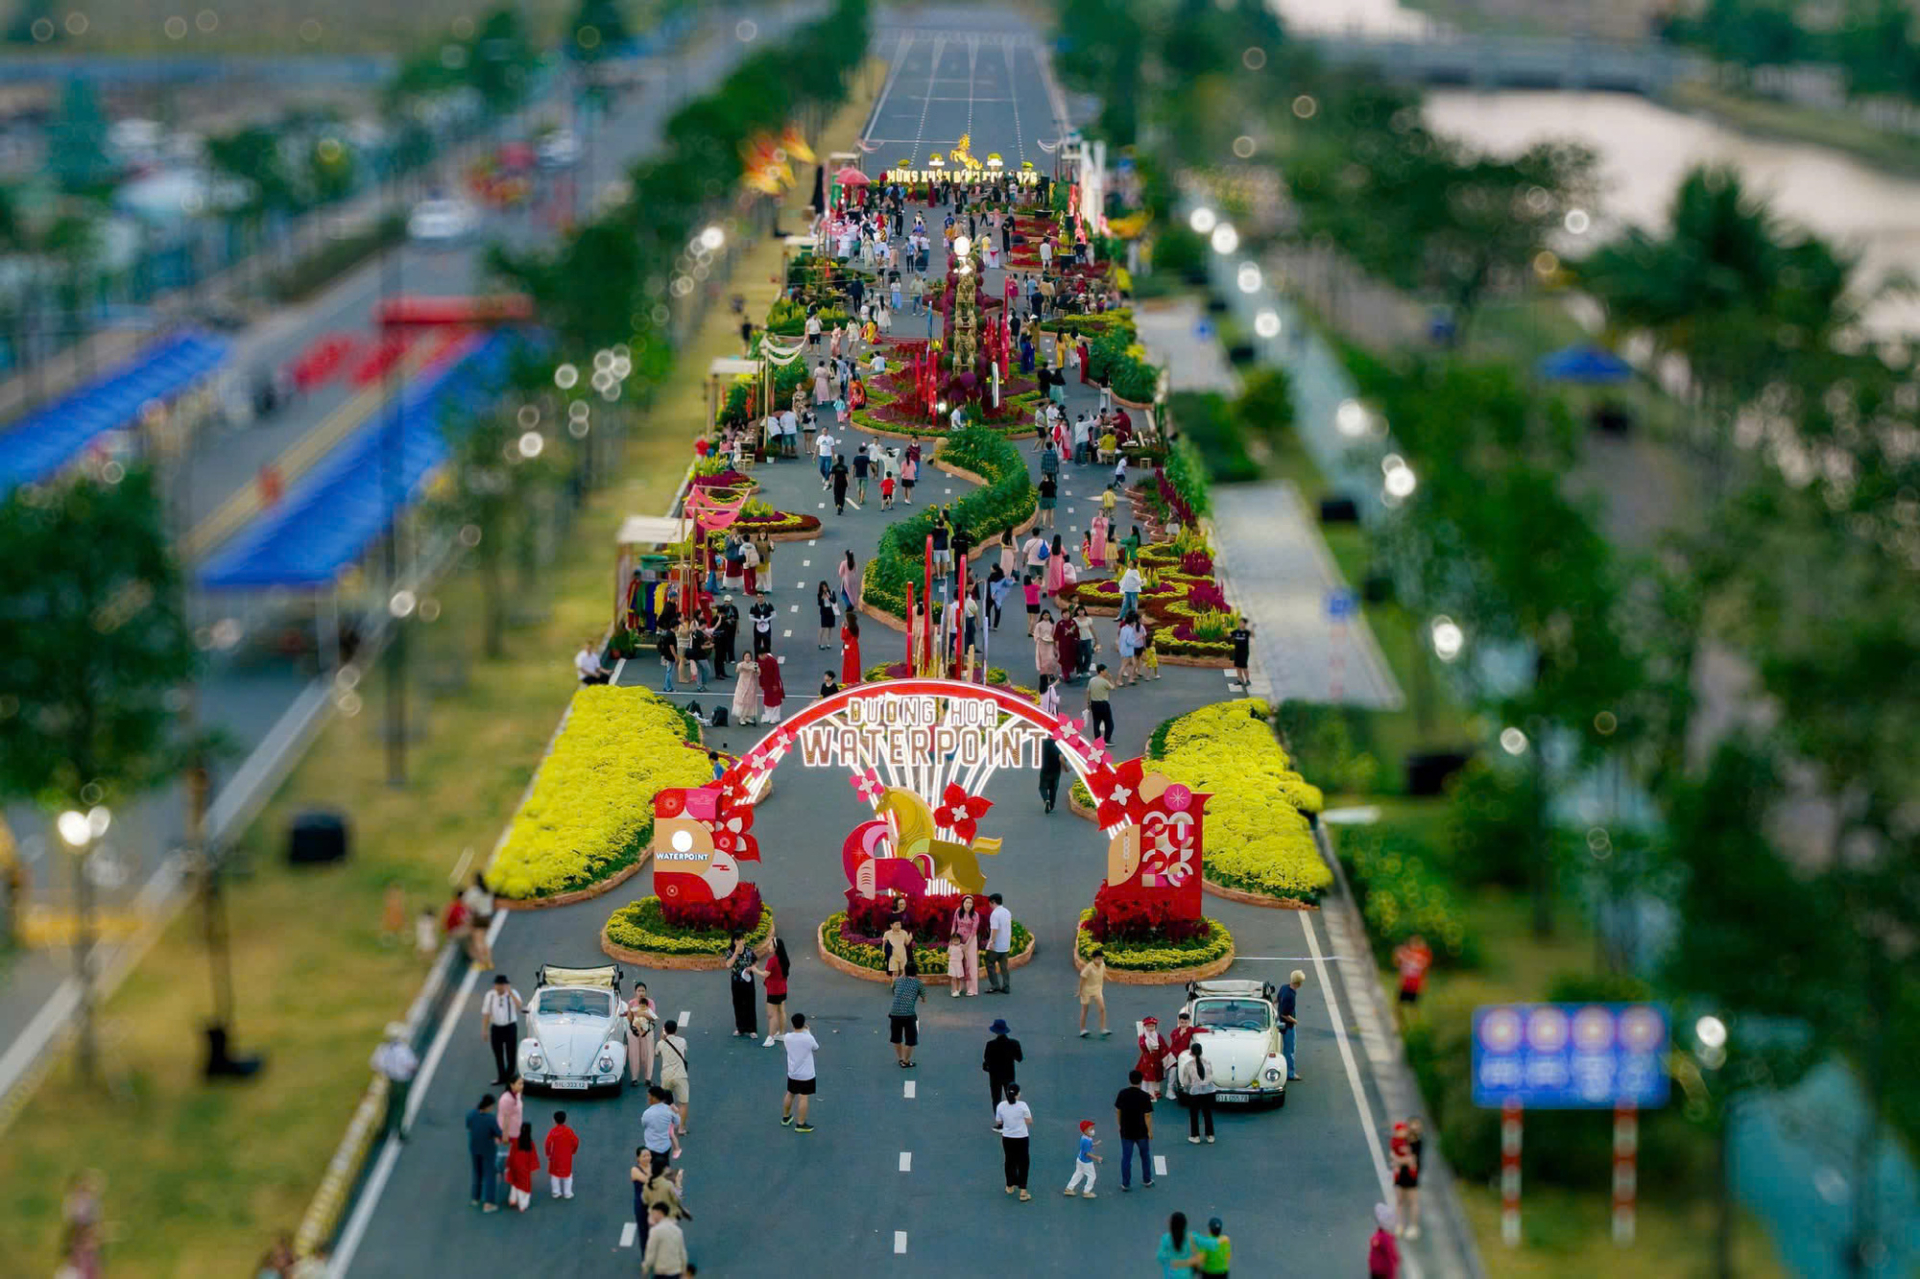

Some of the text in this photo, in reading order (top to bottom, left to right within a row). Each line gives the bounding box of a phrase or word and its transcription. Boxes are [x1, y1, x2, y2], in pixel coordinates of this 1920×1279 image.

[949, 698, 998, 727] HOA
[801, 726, 1051, 768] WATERPOINT
[656, 852, 709, 861] WATERPOINT
